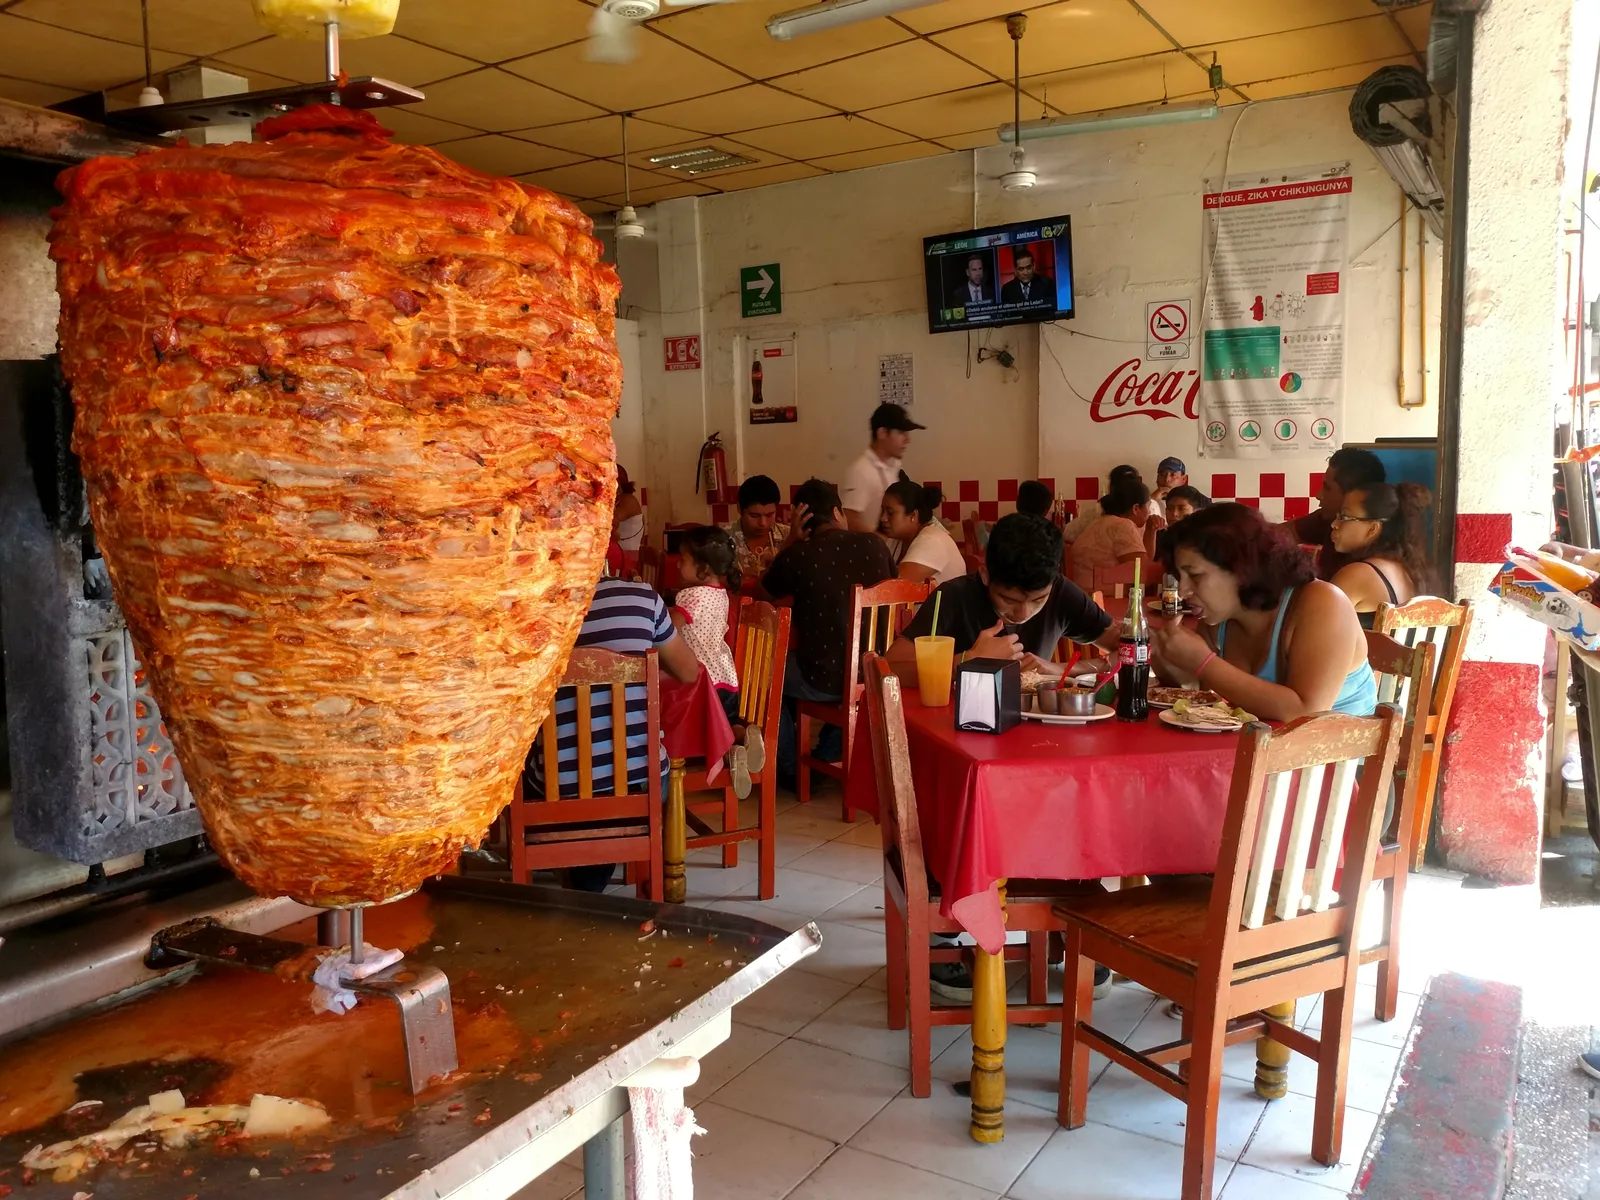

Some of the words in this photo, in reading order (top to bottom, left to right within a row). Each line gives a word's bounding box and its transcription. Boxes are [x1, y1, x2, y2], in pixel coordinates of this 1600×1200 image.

[1206, 194, 1246, 205] DENGUE,
[1247, 191, 1269, 201] ZIKA
[1270, 190, 1278, 198] Y
[1278, 181, 1349, 197] CHIKUNGUNYA
